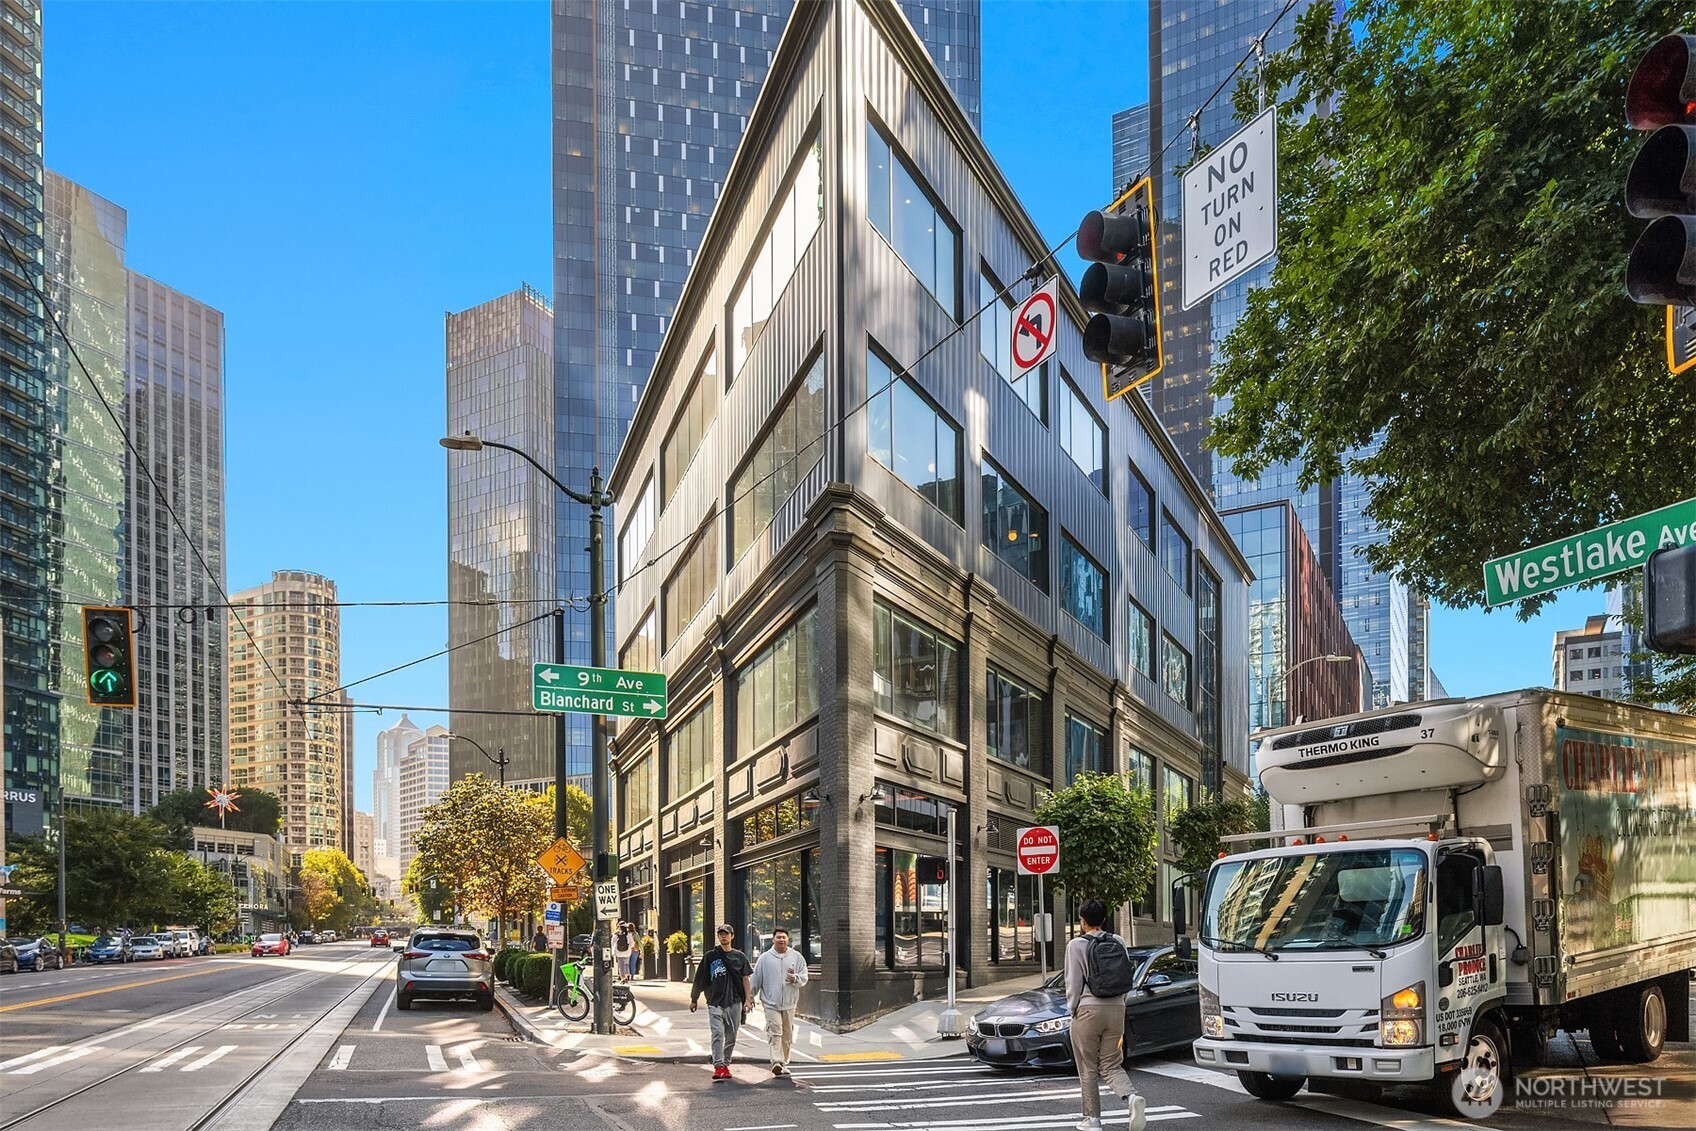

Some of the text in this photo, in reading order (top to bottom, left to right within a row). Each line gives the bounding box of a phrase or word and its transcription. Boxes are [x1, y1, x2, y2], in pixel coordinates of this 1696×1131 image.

[1208, 141, 1248, 194] NO
[1201, 171, 1254, 226] TURN
[1214, 211, 1241, 247] ON
[1209, 240, 1248, 282] RED
[1494, 523, 1696, 595] Westlake Ave
[577, 671, 643, 690] 9th Ave
[540, 690, 635, 713] Blanchard St
[1420, 728, 1435, 740] 37
[1298, 736, 1380, 758] THERMO KING
[1023, 835, 1053, 845] DO NOT
[1027, 856, 1051, 866] ENTER
[550, 867, 573, 875] TRACKS
[597, 884, 616, 895] ONE
[598, 895, 617, 905] WAY
[1271, 992, 1319, 1002] ISUZU
[1435, 1013, 1444, 1023] US
[1445, 1010, 1456, 1021] DOT
